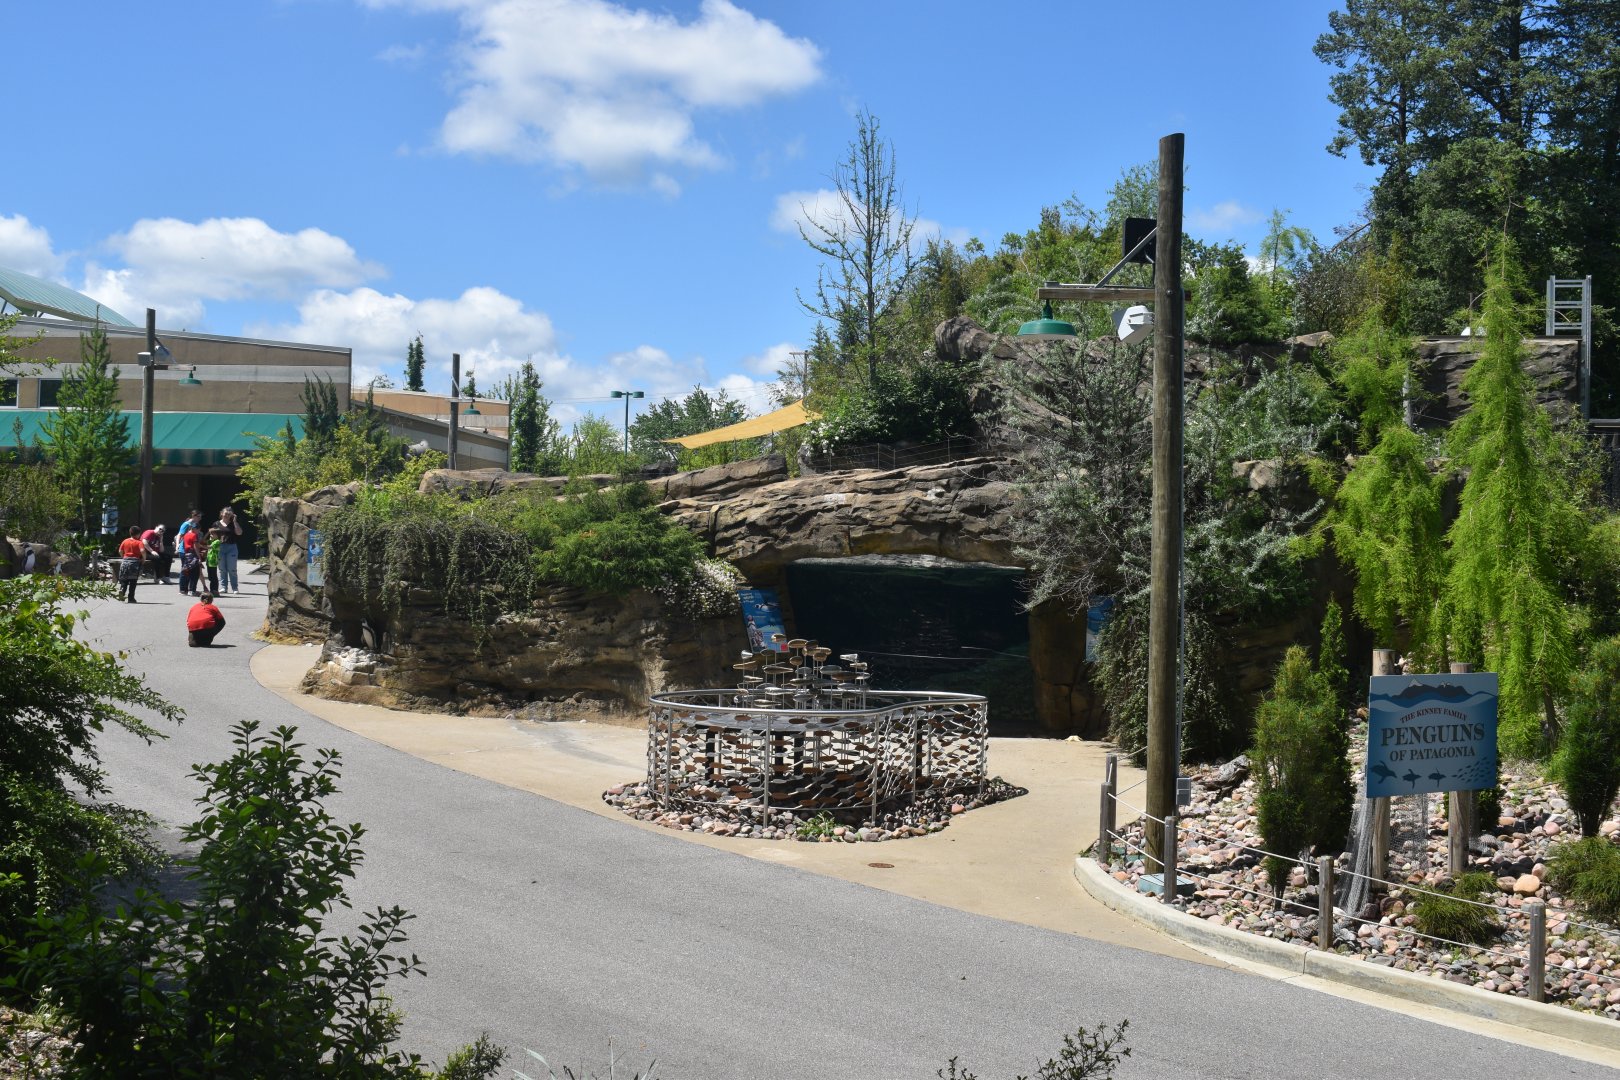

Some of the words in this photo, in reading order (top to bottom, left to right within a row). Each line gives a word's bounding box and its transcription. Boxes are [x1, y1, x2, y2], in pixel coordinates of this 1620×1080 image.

[1400, 712, 1416, 724] THE
[1416, 707, 1443, 717] KINNEY
[1443, 708, 1467, 721] FAMILY
[1380, 722, 1485, 747] PENGUINS
[1389, 750, 1407, 762] OF
[1410, 746, 1475, 761] PATAGONIA
